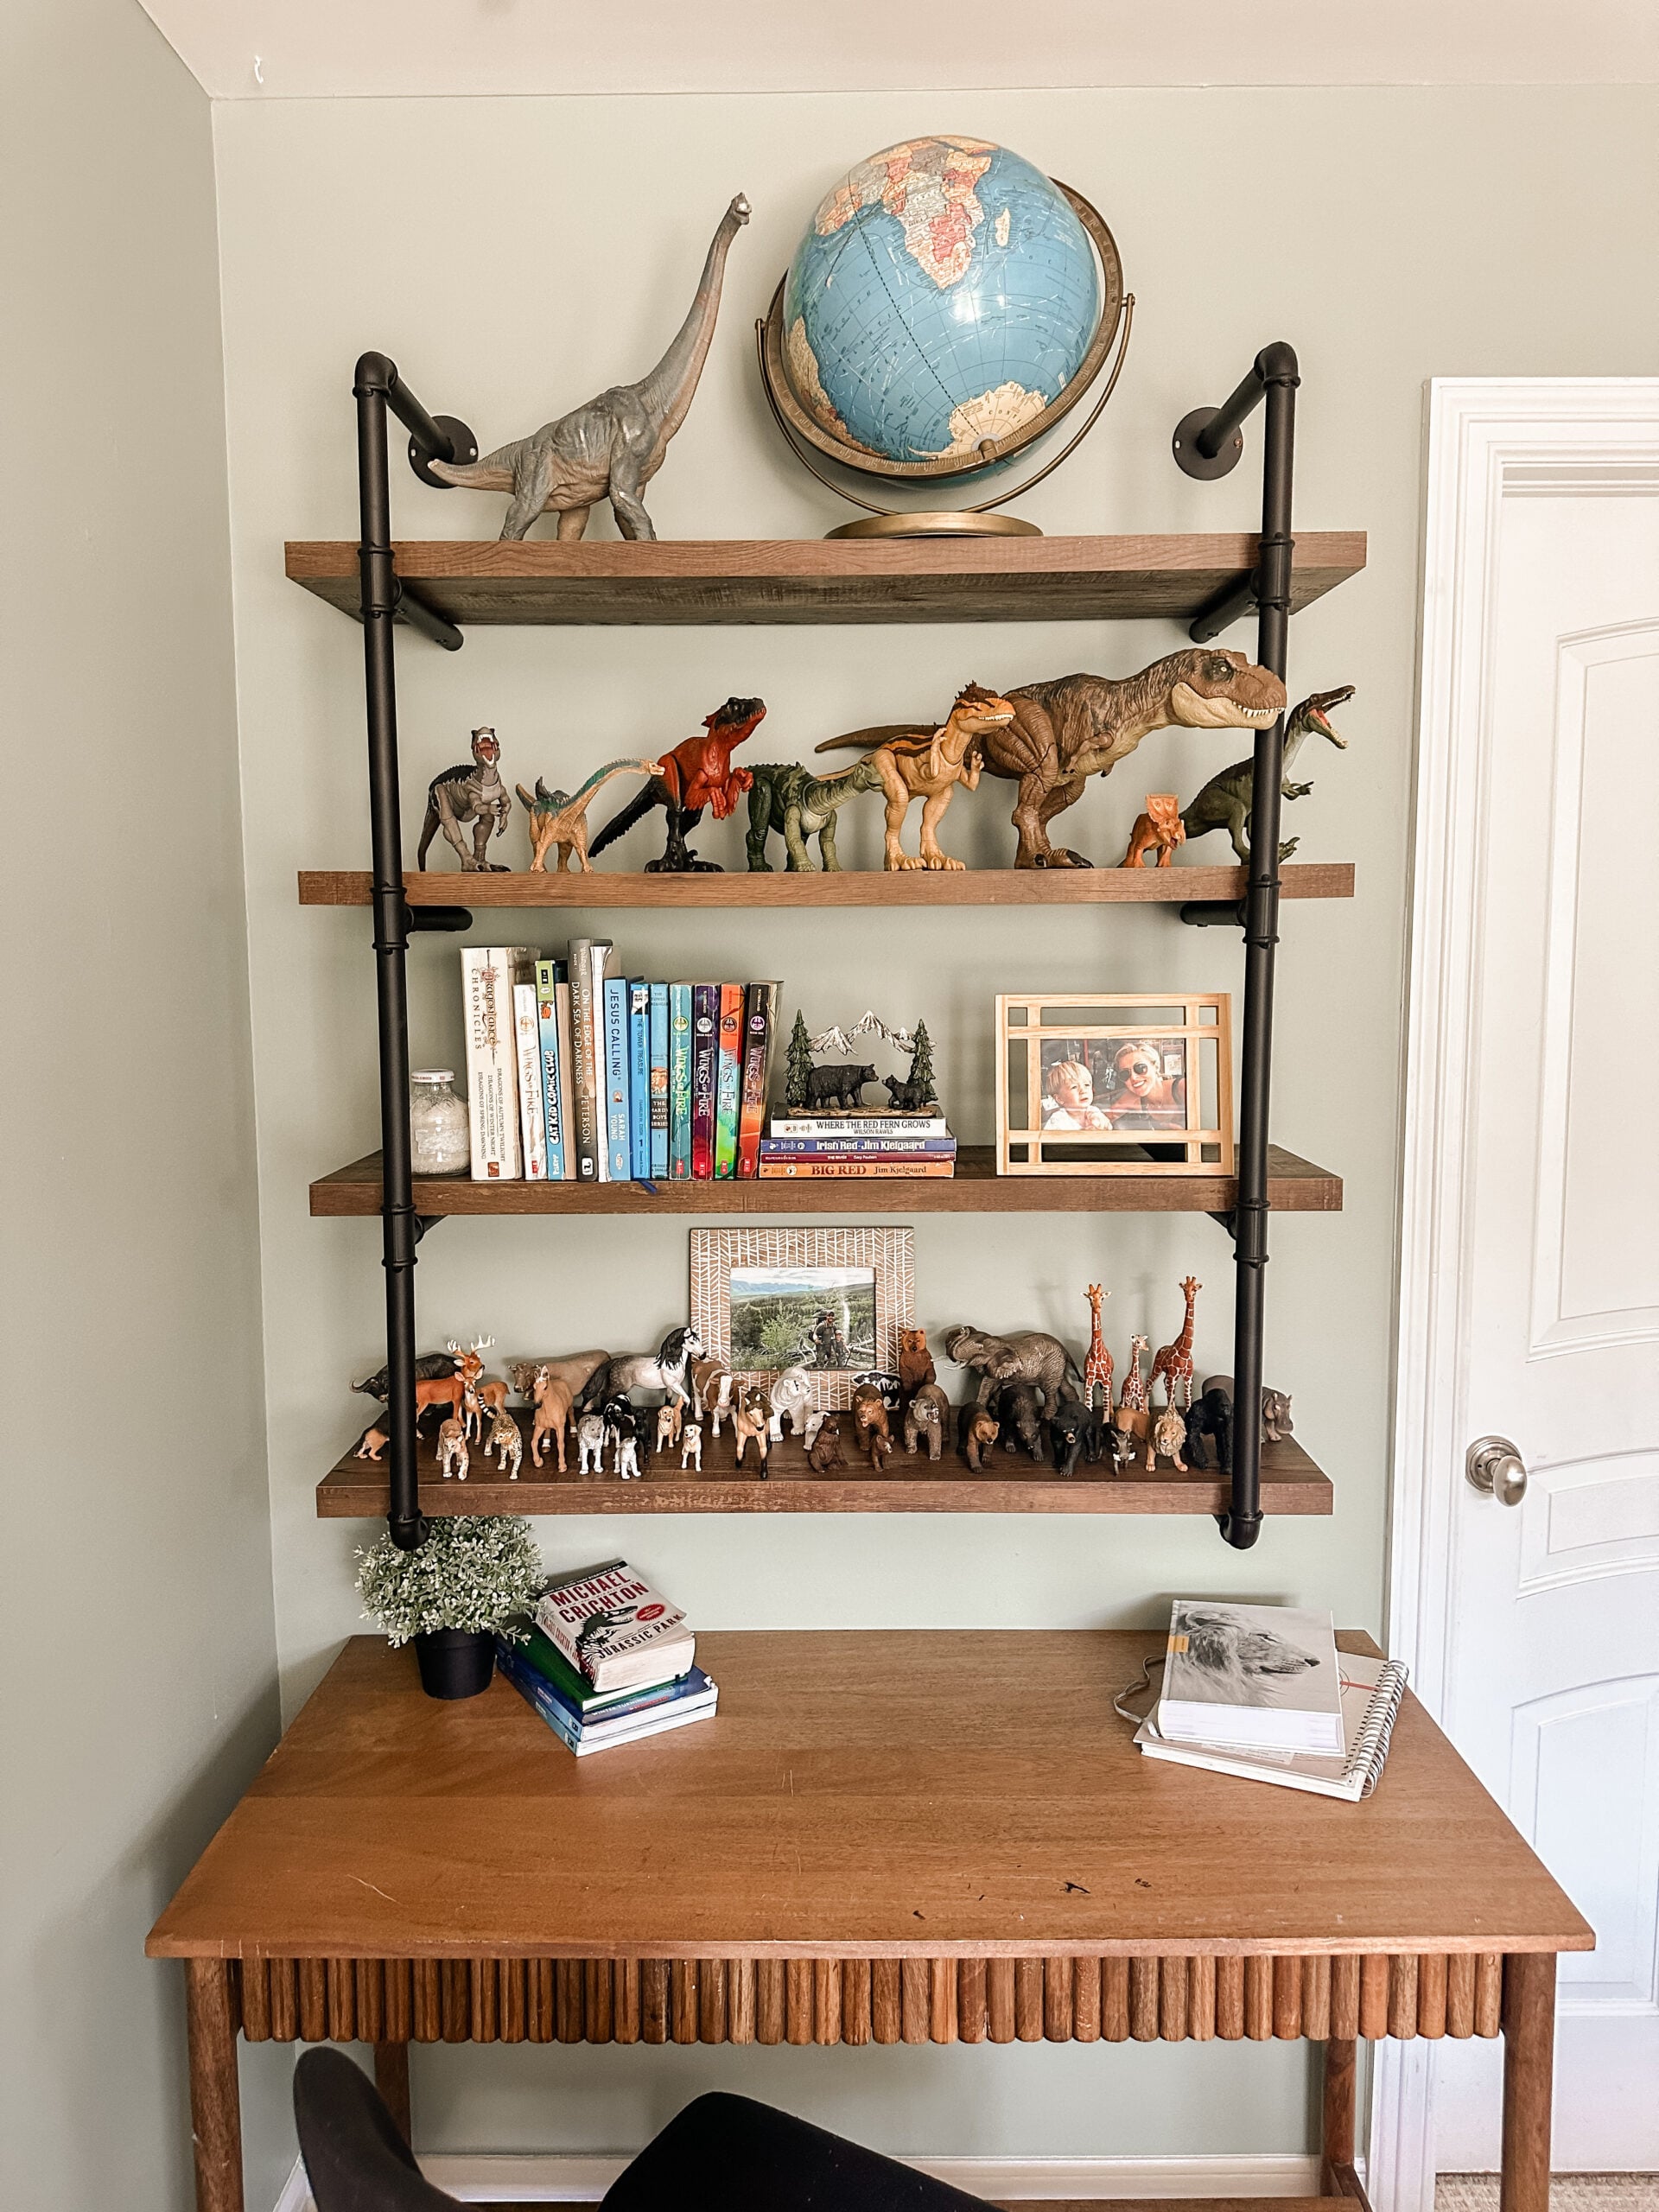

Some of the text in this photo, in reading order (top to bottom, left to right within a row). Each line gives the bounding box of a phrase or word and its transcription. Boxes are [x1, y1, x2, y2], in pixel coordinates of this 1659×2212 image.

[472, 968, 482, 1050] CHRONICLES
[582, 988, 590, 1004] ON
[610, 988, 620, 1025] JESUS
[574, 1027, 581, 1039] OF
[524, 1046, 536, 1081] WINGS
[544, 1050, 555, 1074] CLUB
[574, 1040, 583, 1084] DARKNESS
[585, 1049, 593, 1059] OF
[675, 1046, 690, 1080] WINGS
[697, 1047, 714, 1084] WINGS
[721, 1048, 736, 1082] WINGS
[747, 1046, 764, 1081] WINGS
[525, 1090, 539, 1115] FIRE
[676, 1089, 690, 1116] FIRE
[698, 1091, 713, 1116] FIRE
[721, 1090, 734, 1115] FIRE
[549, 1125, 560, 1144] CAT
[581, 1095, 591, 1144] PETERSON
[816, 1121, 846, 1129] WHERE
[880, 1120, 899, 1128] FERN
[902, 1120, 931, 1128] GROWS
[817, 1141, 838, 1150] Irish
[880, 1141, 925, 1151] Kjelgaard
[811, 1166, 835, 1175] BIG
[837, 1166, 867, 1174] RED
[550, 1572, 631, 1607] MICHAEL
[558, 1581, 650, 1624] CRICHTON
[598, 1631, 653, 1659] JURASSIC
[655, 1614, 683, 1634] PARK
